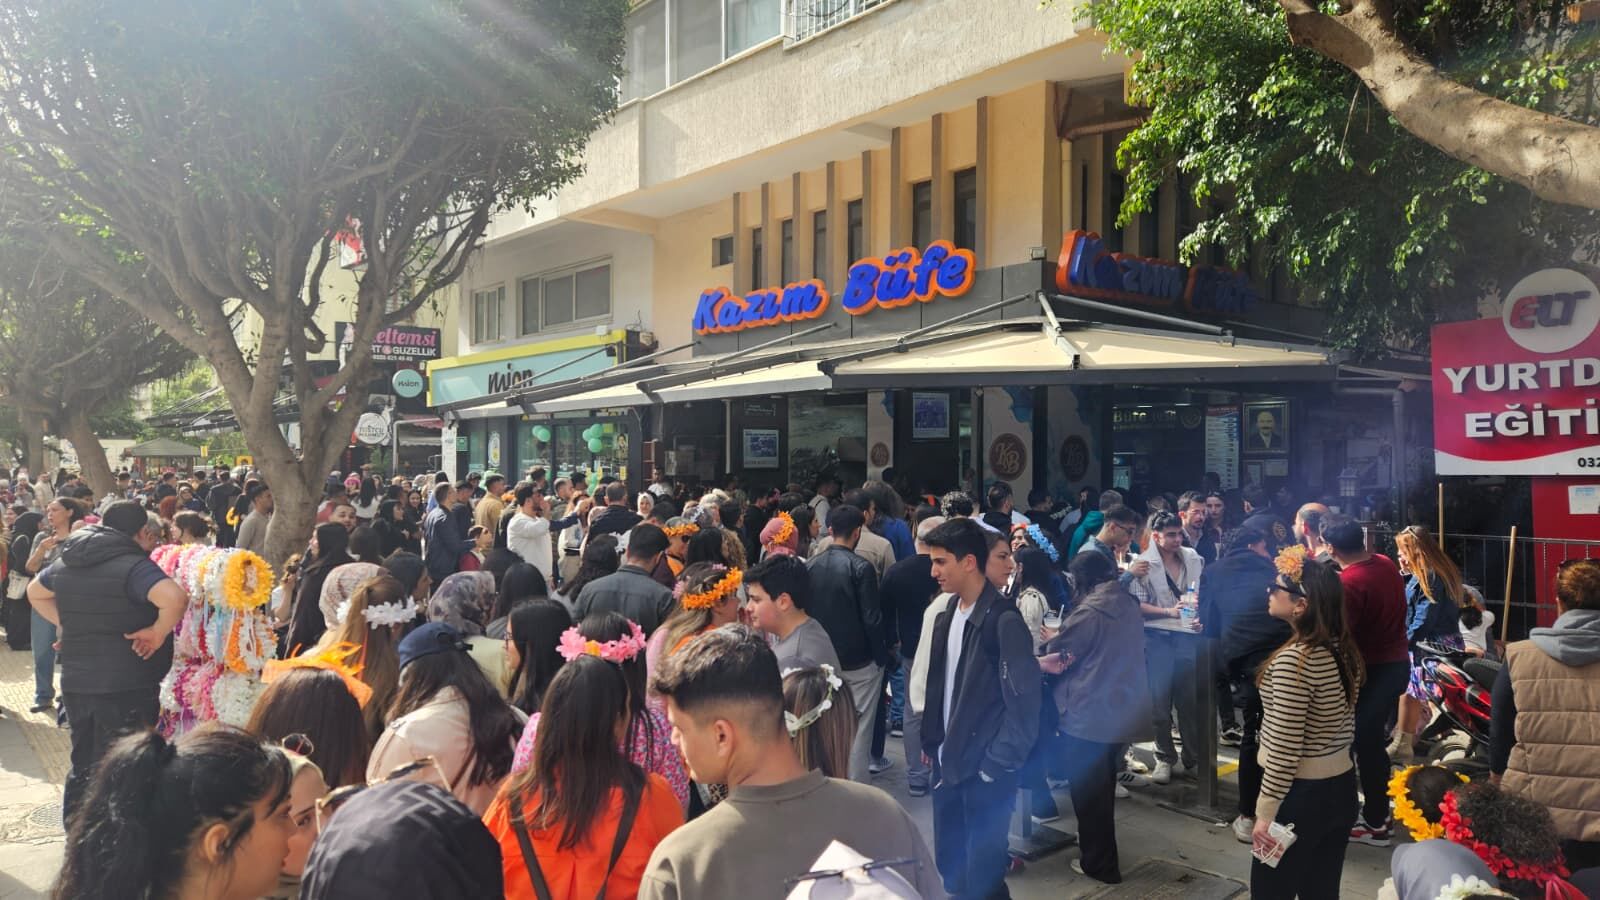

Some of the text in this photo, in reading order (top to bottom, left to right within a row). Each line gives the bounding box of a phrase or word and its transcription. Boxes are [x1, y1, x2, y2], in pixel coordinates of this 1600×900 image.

[693, 240, 975, 334] Kazım Büfe
[373, 328, 436, 347] eltemsi
